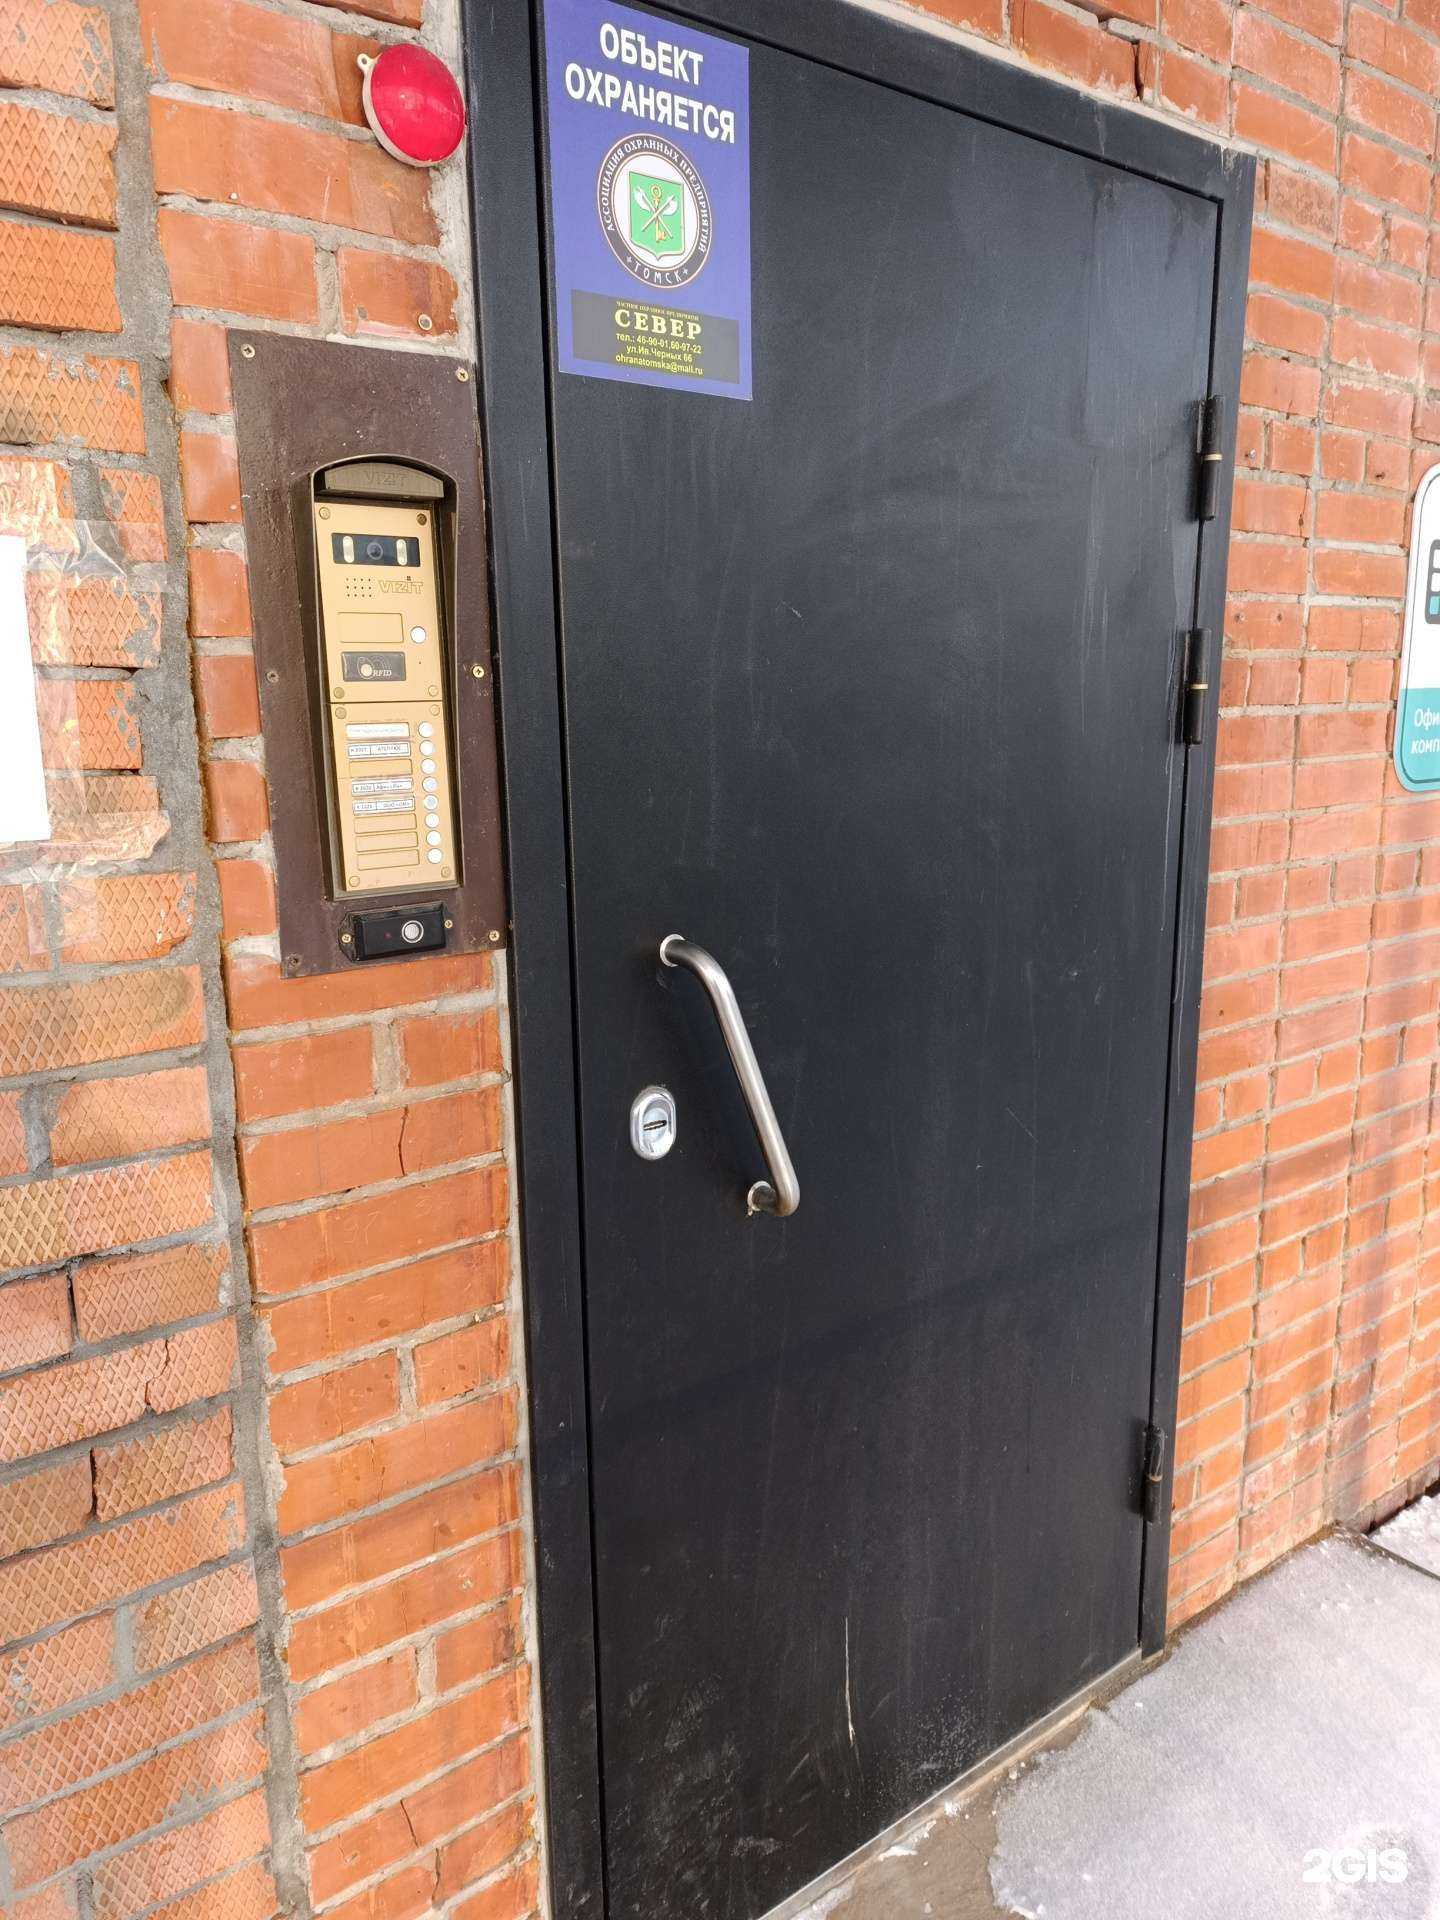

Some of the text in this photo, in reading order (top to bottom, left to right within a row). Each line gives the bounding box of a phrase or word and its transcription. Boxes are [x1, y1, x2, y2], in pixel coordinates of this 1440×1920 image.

[600, 23, 703, 86] ОБЪЕКТ
[565, 62, 735, 144] ОХРАНЯЕТСЯ
[600, 148, 626, 232] АССОЦИАЦИЯ
[624, 138, 679, 162] ОХРАННЫХ
[633, 261, 682, 285] ТОМСК
[614, 309, 702, 340] СЕВЕР
[372, 668, 392, 677] RFID
